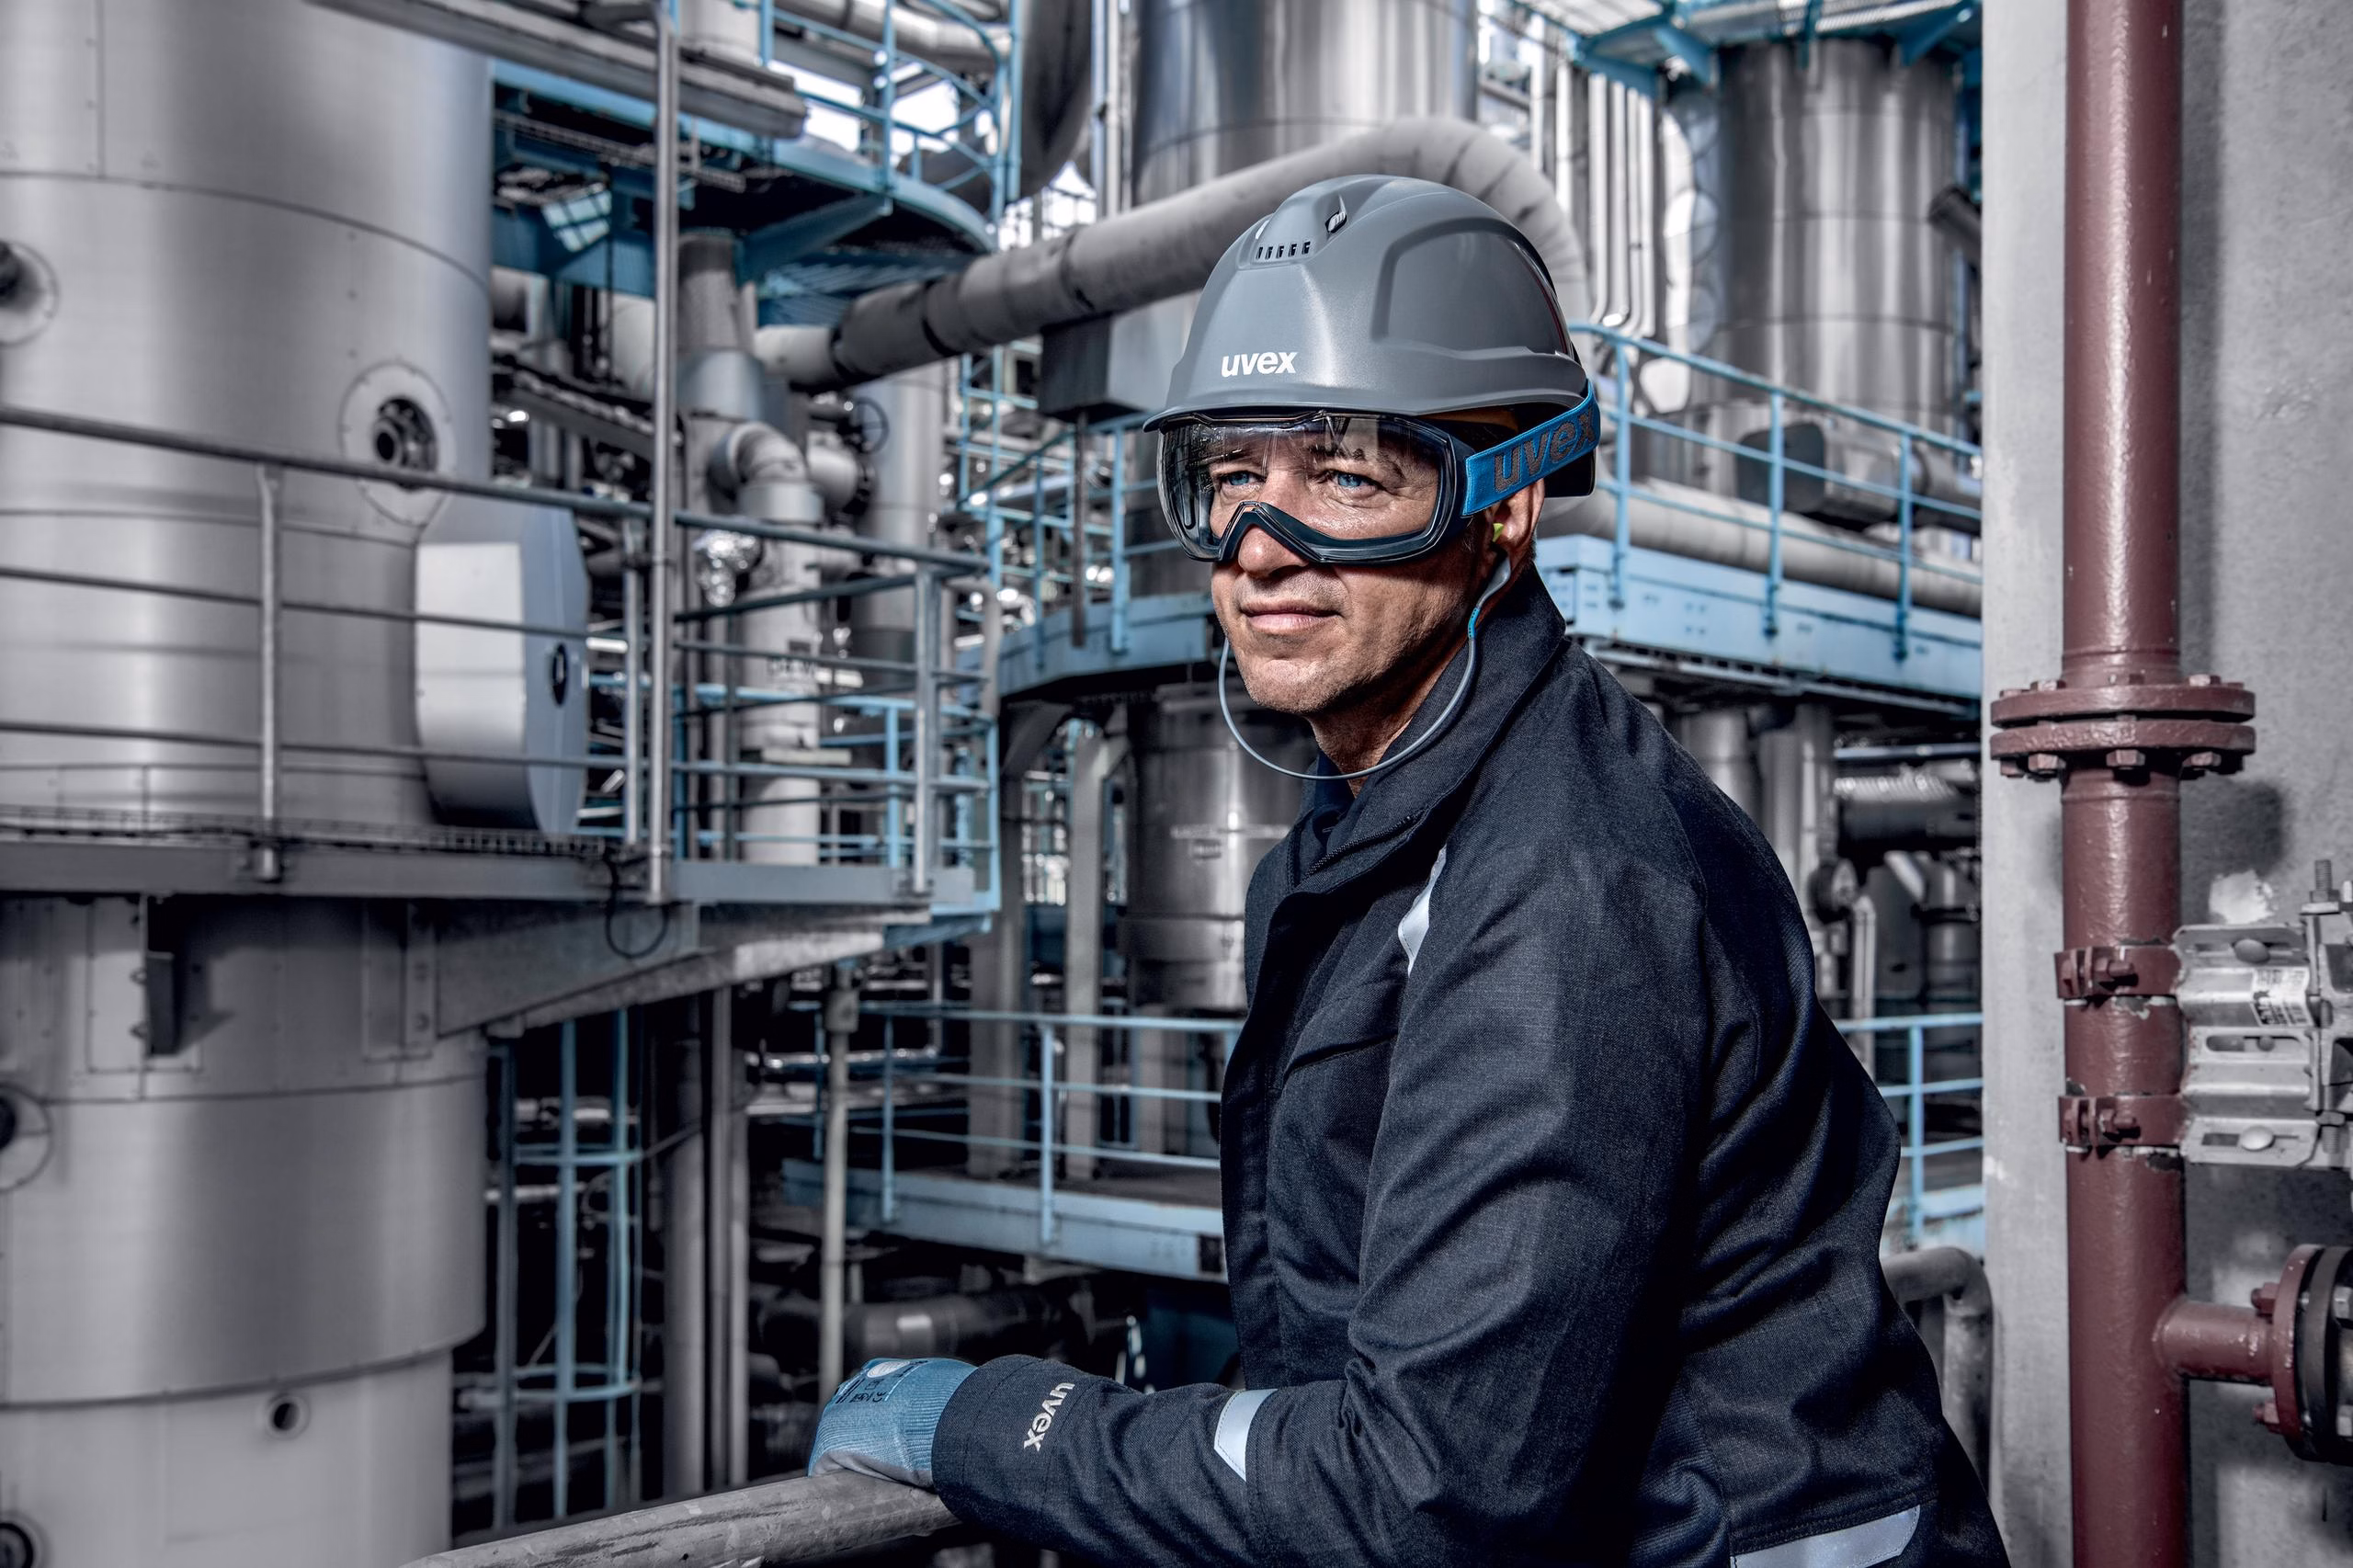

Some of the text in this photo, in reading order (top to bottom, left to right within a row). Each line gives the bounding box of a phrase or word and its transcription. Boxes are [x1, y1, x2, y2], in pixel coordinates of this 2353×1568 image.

[1221, 351, 1299, 378] uvex
[1494, 405, 1596, 492] uvex
[1023, 1382, 1075, 1452] uvex
